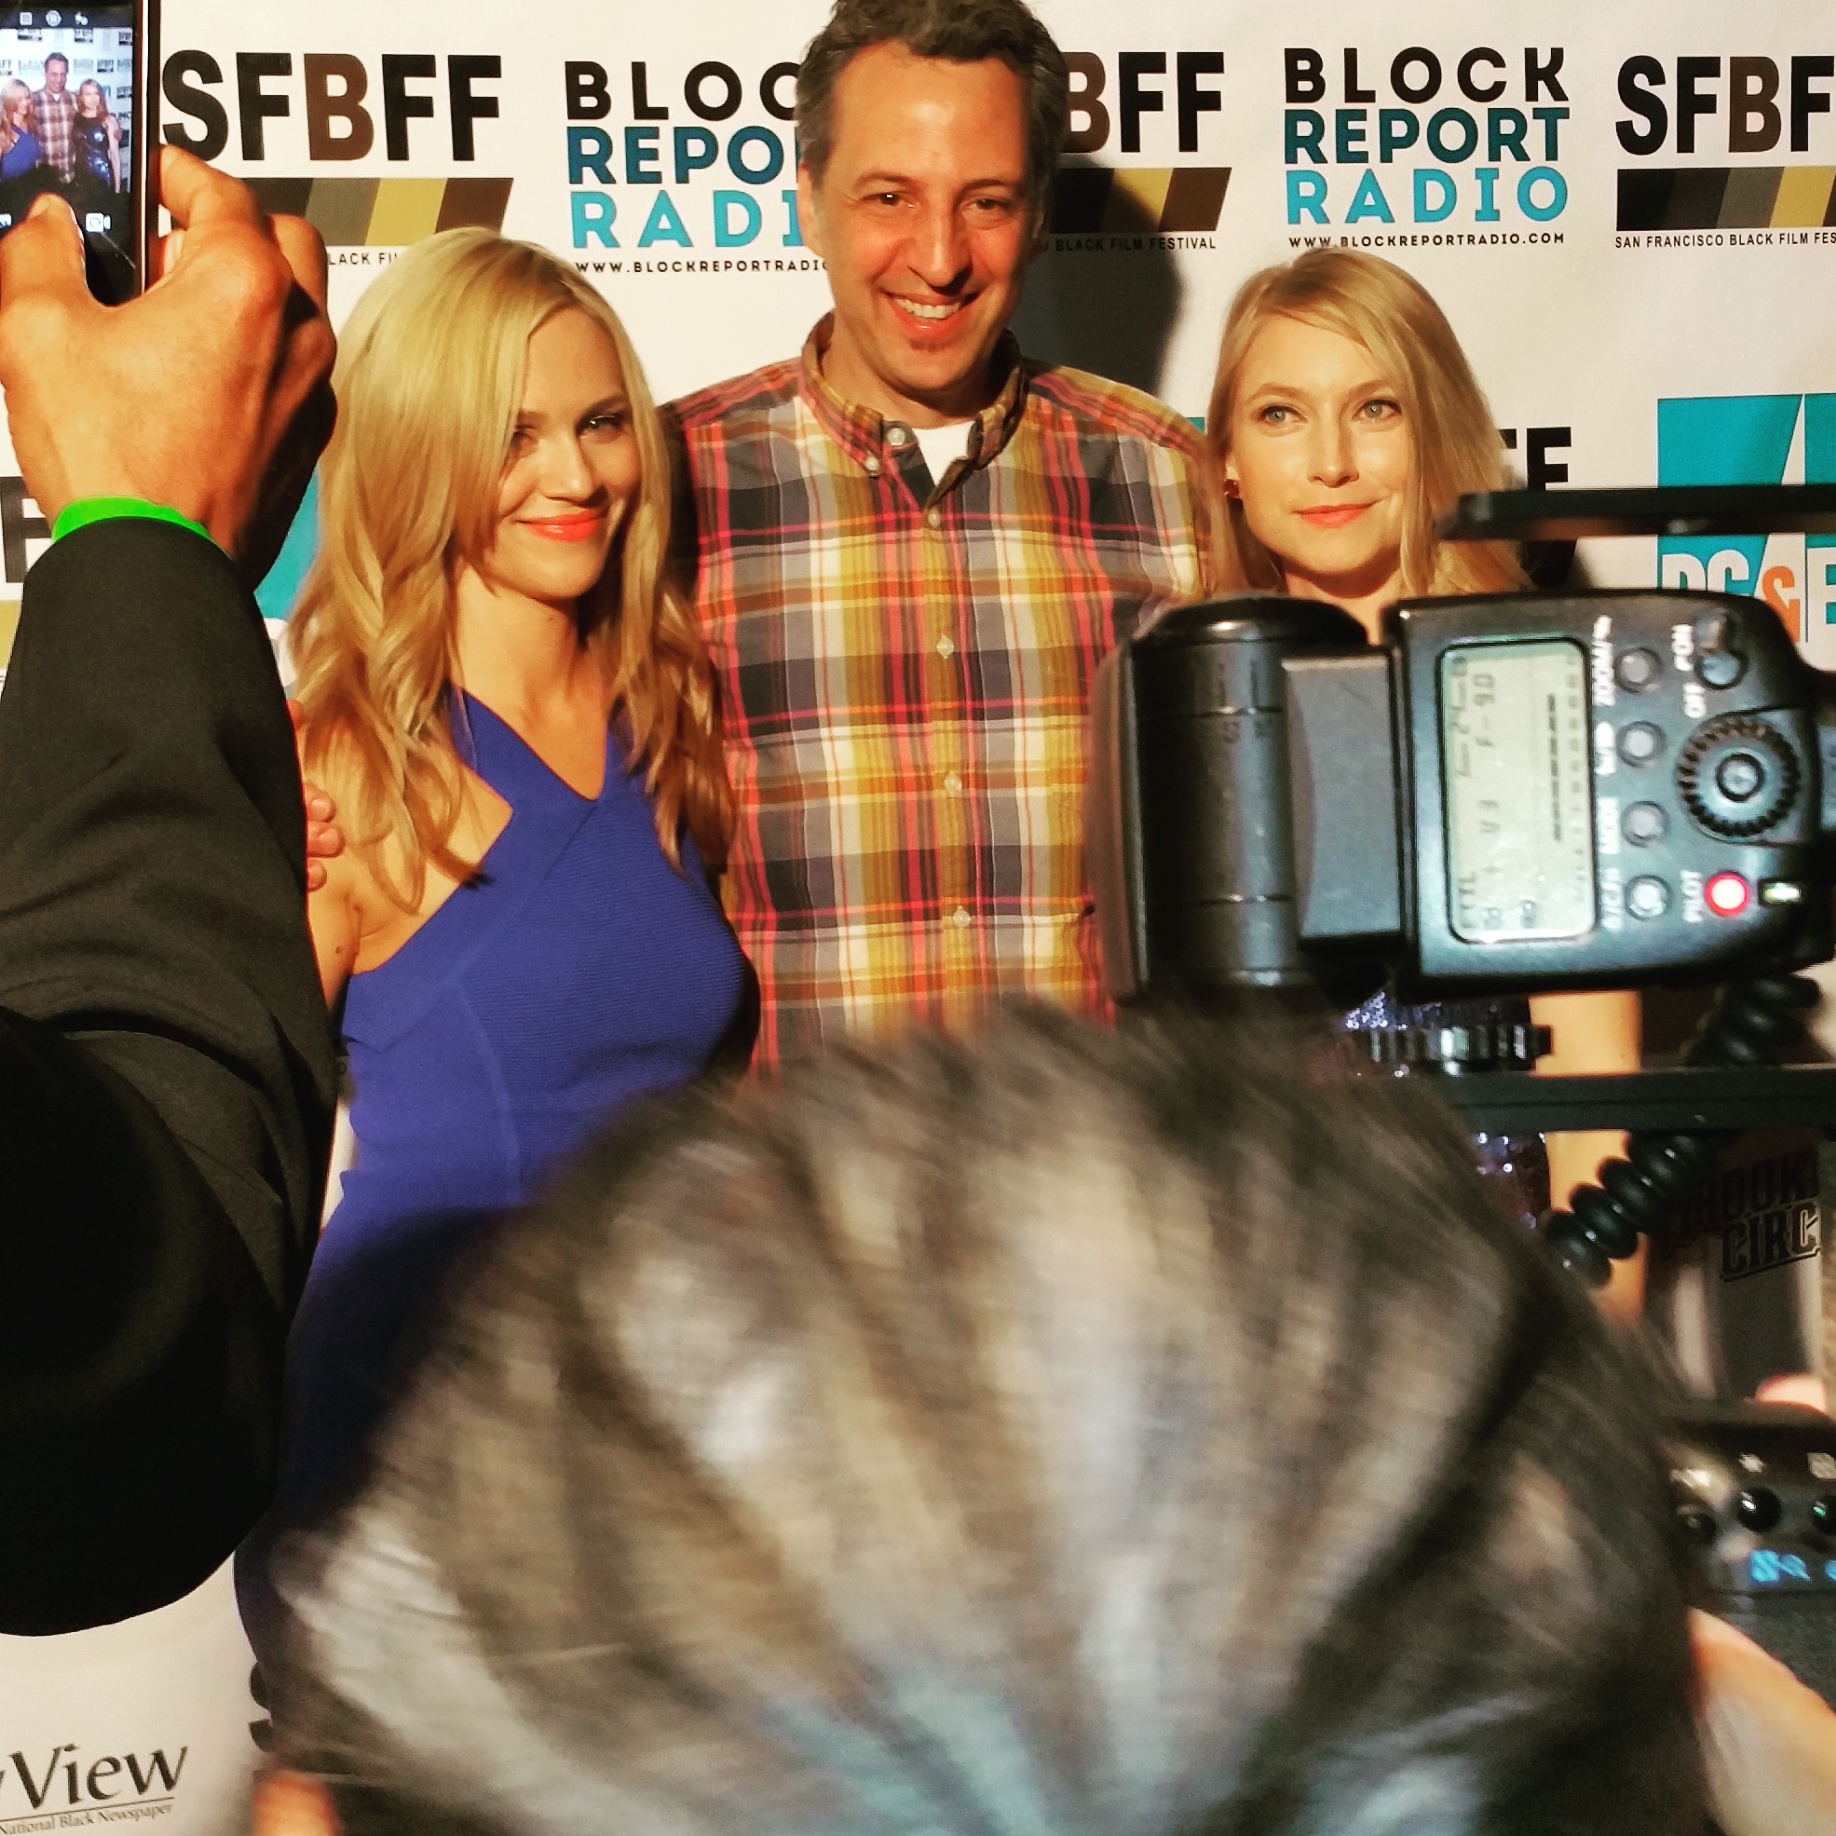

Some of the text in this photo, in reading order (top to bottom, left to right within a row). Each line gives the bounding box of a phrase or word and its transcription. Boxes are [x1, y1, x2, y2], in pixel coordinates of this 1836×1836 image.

[565, 61, 800, 122] BLOC
[1060, 52, 1224, 153] BFF
[1284, 47, 1569, 103] BLOCK
[162, 50, 502, 162] SFBFF
[1615, 55, 1836, 155] SFBF
[566, 126, 800, 185] REPO
[1284, 108, 1570, 164] REPORT
[571, 190, 805, 248] RADI
[1286, 166, 1568, 225] RADIO
[327, 252, 397, 266] LACK FI
[575, 259, 828, 273] WWW.BLOCKREPORTRADI
[1055, 239, 1102, 252] BLACK
[1110, 239, 1143, 251] FILM
[1150, 237, 1217, 250] FESTIVAL
[1288, 233, 1565, 247] WWW.BLOCKREPORTRADIO.COM
[1615, 231, 1836, 248] SAN FRANCISCO BLACK FILM FES
[1721, 1202, 1819, 1274] CIRC
[60, 1811, 94, 1828] Black
[98, 1804, 173, 1822] Newspaper
